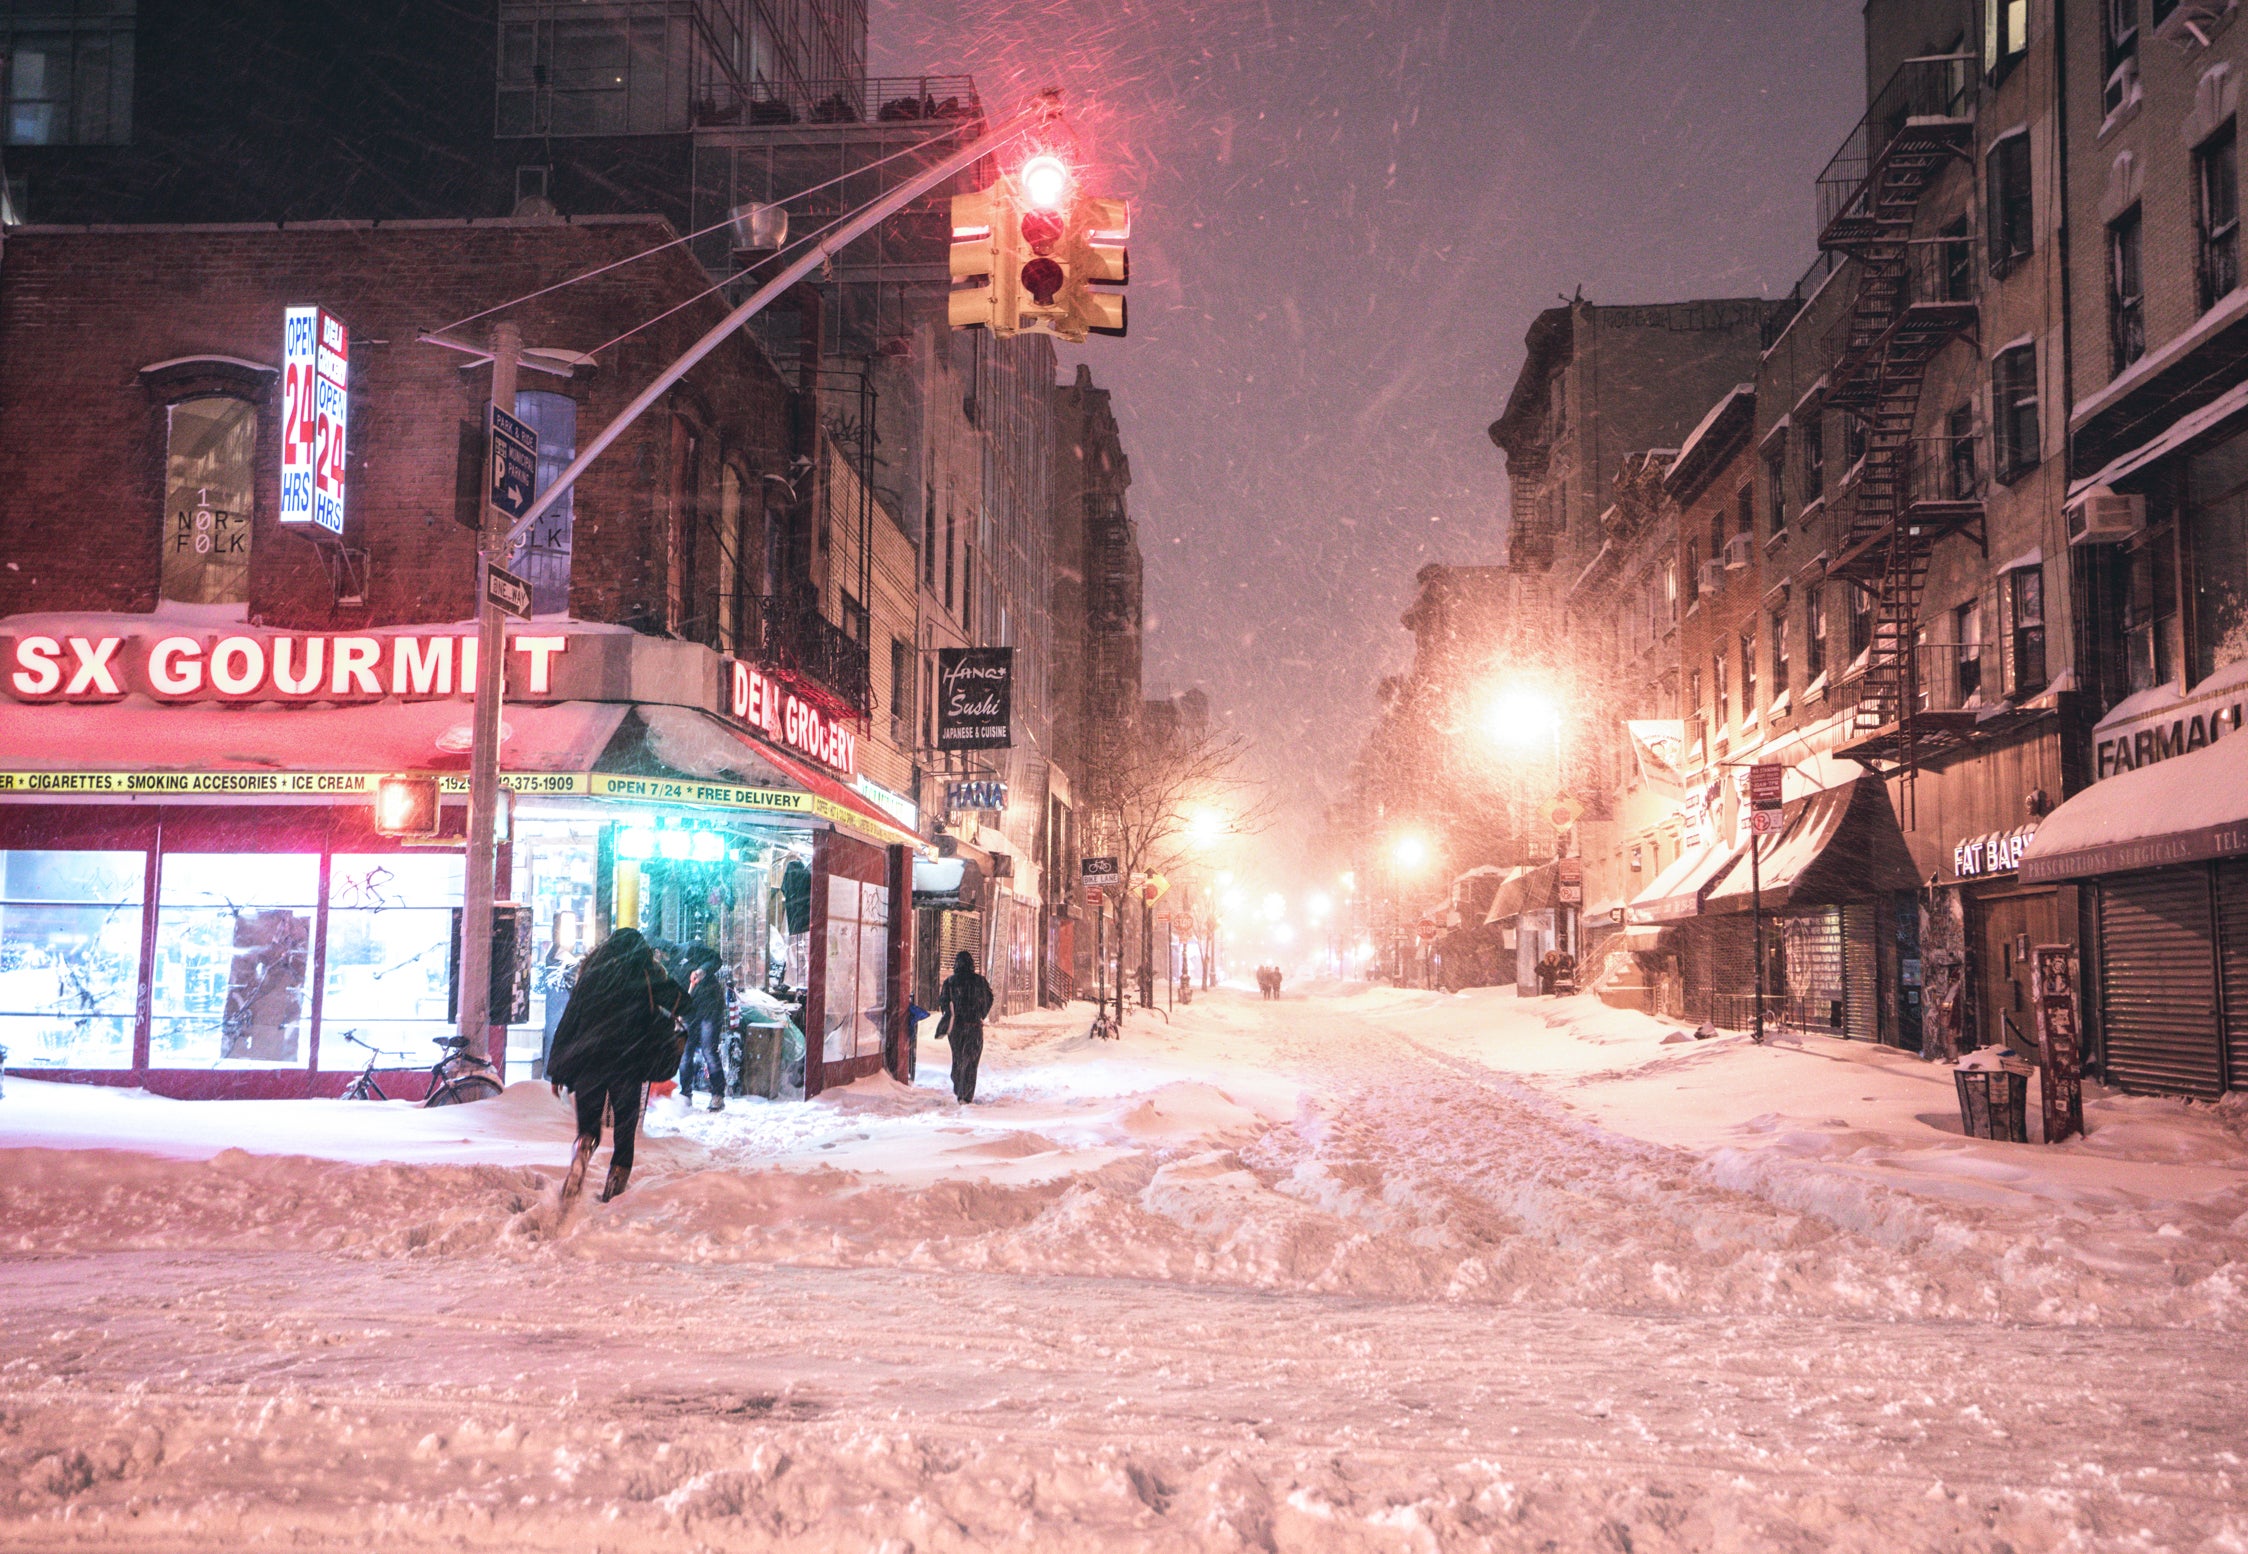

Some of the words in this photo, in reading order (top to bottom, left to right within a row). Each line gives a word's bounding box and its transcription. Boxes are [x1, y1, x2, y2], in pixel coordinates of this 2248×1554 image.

[288, 316, 316, 356] OPEN
[324, 315, 343, 352] DELI
[285, 362, 315, 465] 24
[318, 380, 345, 420] OPEN
[496, 413, 513, 435] PARK
[514, 426, 520, 439] &
[521, 431, 534, 449] RIDE
[316, 411, 345, 499] 24
[281, 472, 310, 512] HRS
[316, 493, 341, 532] HRS
[493, 577, 507, 598] ONE
[512, 587, 526, 608] WAY
[12, 636, 121, 695] SX
[948, 693, 1001, 717] Sushi
[785, 694, 856, 775] GROCERY
[942, 726, 974, 740] JAPANESE
[975, 727, 980, 739] &
[981, 725, 1007, 739] CUISINE
[28, 774, 112, 789] CIGARETTES
[127, 775, 188, 789] SMOKING
[192, 775, 277, 790] ACCESORIES
[292, 776, 313, 790] ICE
[317, 776, 365, 790] CREAM
[607, 779, 646, 795] OPEN
[650, 783, 682, 799] 7/24
[697, 786, 731, 802] FREE
[735, 790, 801, 808] DELIVERY
[948, 782, 1004, 809] HANA
[1954, 842, 1984, 877] FAT
[2028, 852, 2108, 878] PRESCRIPTIONS
[2214, 830, 2247, 852] TEL:
[1084, 875, 1098, 885] BIKE
[1101, 874, 1117, 883] LANE
